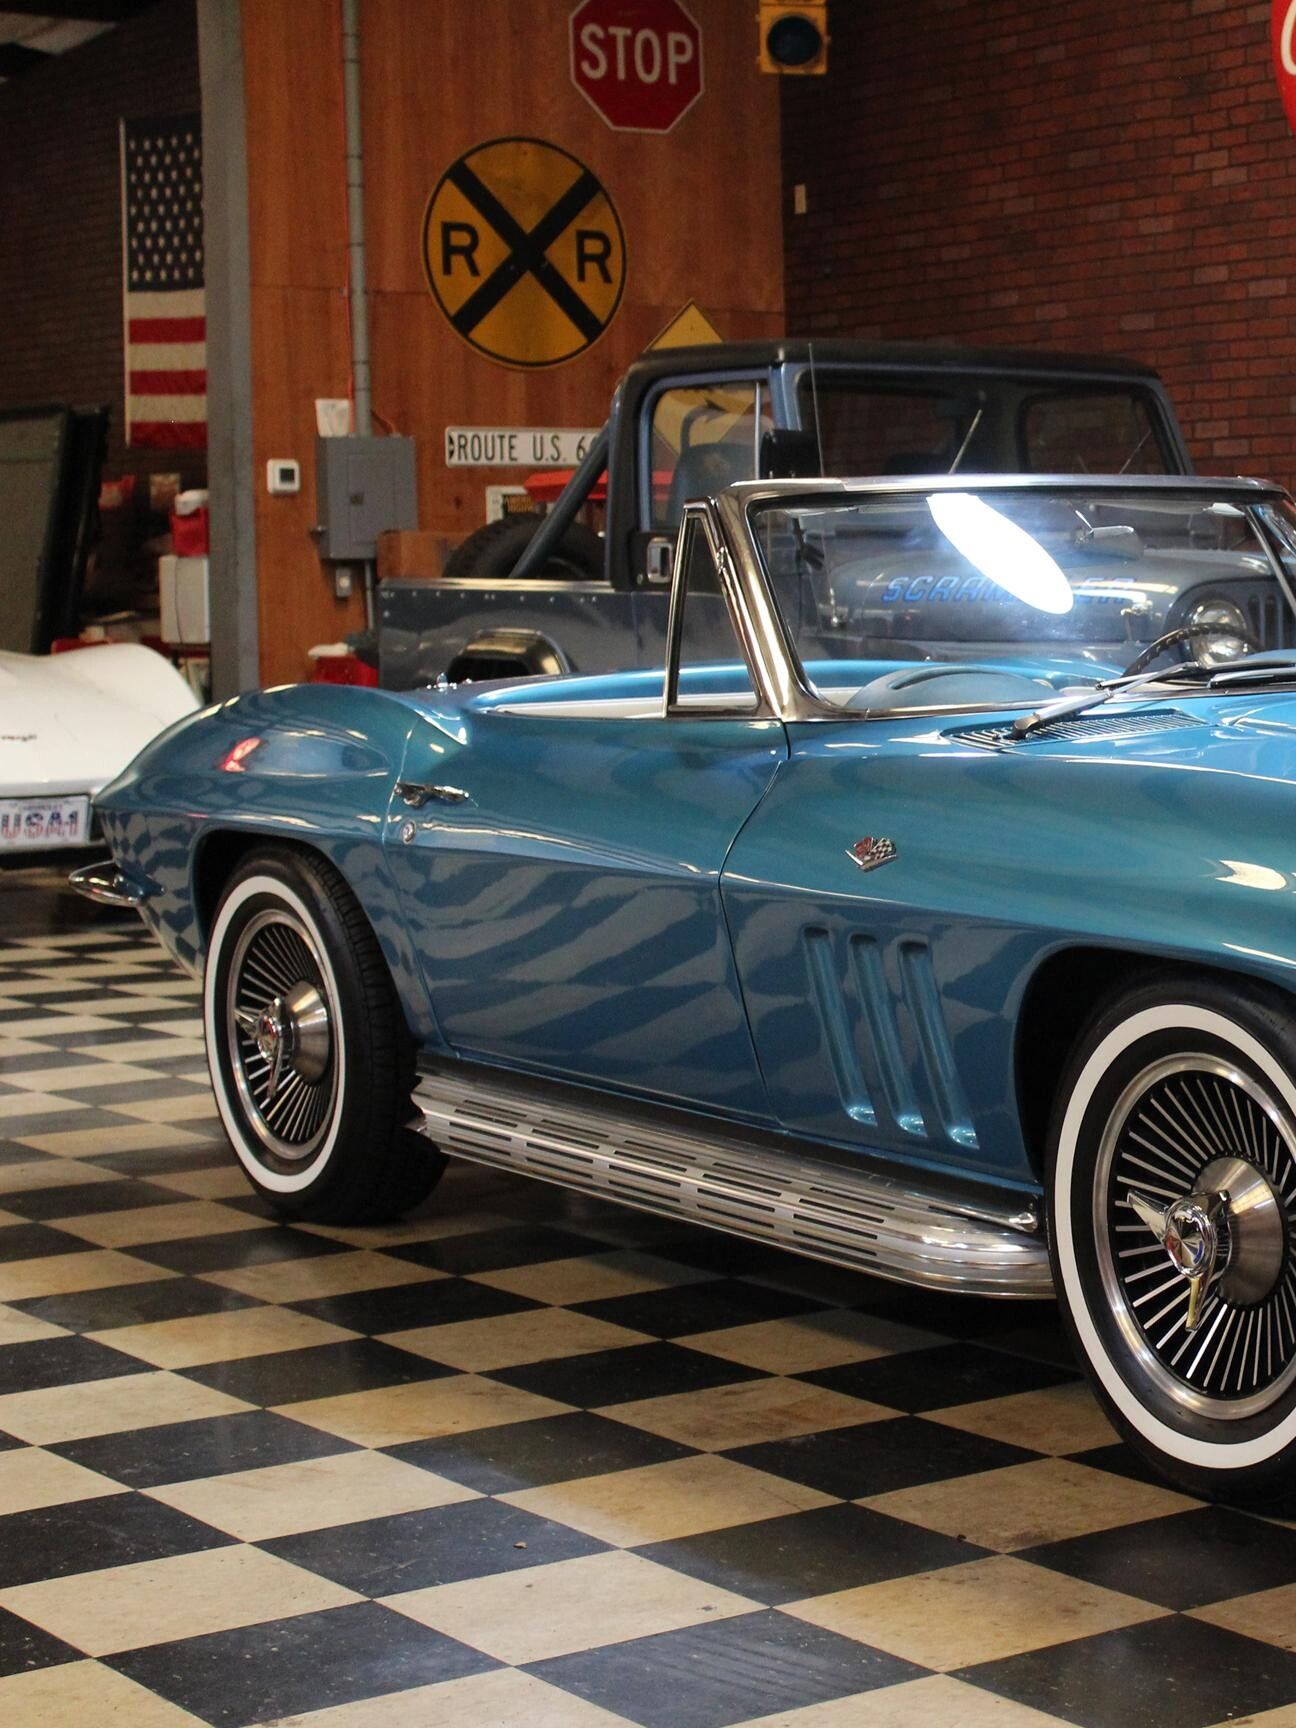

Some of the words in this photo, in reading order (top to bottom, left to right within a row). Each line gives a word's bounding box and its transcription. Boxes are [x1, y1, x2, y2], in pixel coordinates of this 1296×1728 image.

[580, 23, 693, 85] STOP
[457, 434, 518, 462] ROUTE
[533, 434, 567, 462] U.S.
